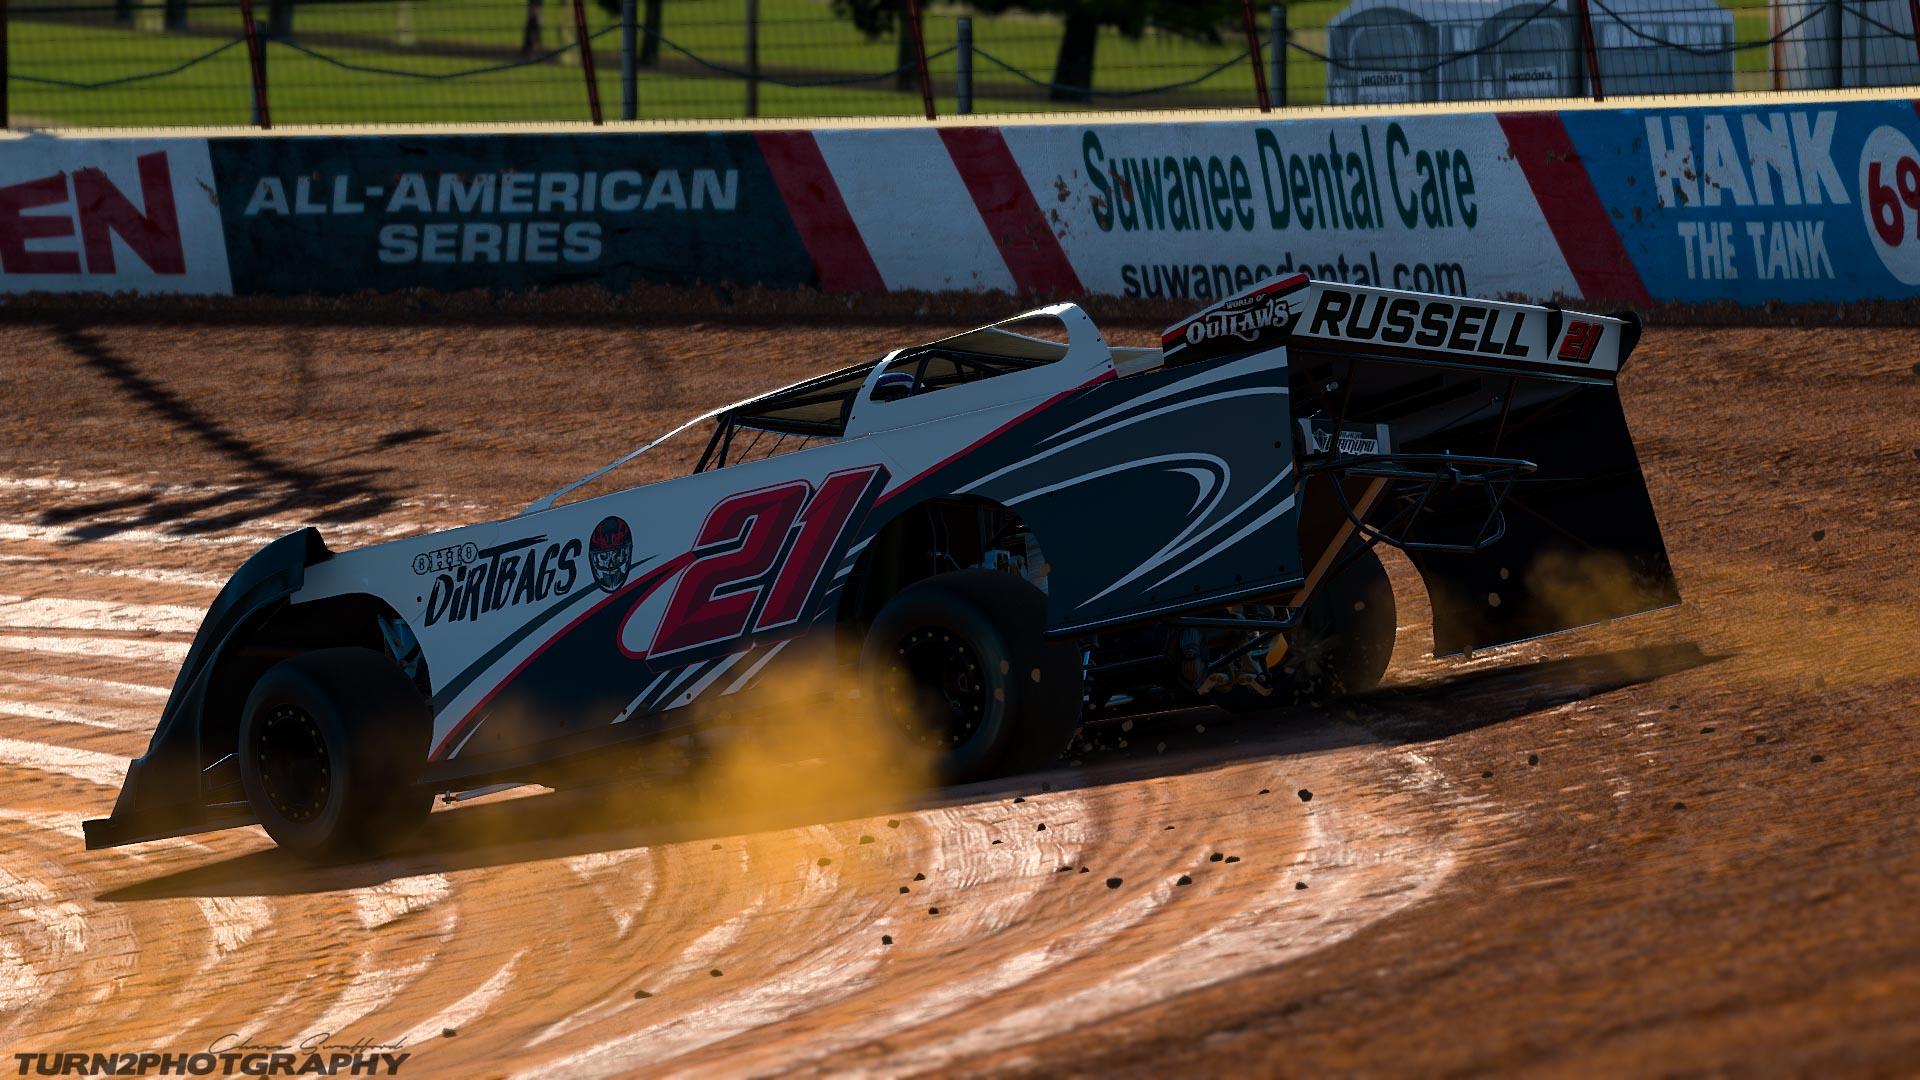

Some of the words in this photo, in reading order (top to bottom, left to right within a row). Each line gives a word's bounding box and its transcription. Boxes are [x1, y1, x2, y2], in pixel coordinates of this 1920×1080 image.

[1082, 129, 1254, 233] Suwanee
[1255, 124, 1384, 231] Dental
[1386, 122, 1477, 229] Care
[1645, 111, 1851, 208] HANK
[244, 169, 738, 215] ALL-AMERICAN
[377, 221, 603, 263] SERIES
[1677, 221, 1738, 279] THE
[1746, 220, 1835, 279] TANK
[1120, 250, 1467, 300] suwanedntalcom
[1226, 296, 1254, 308] WORLD
[1309, 289, 1530, 357] RUSSELL
[1557, 318, 1602, 363] 21
[412, 542, 478, 575] OHIO
[646, 464, 890, 670] 21
